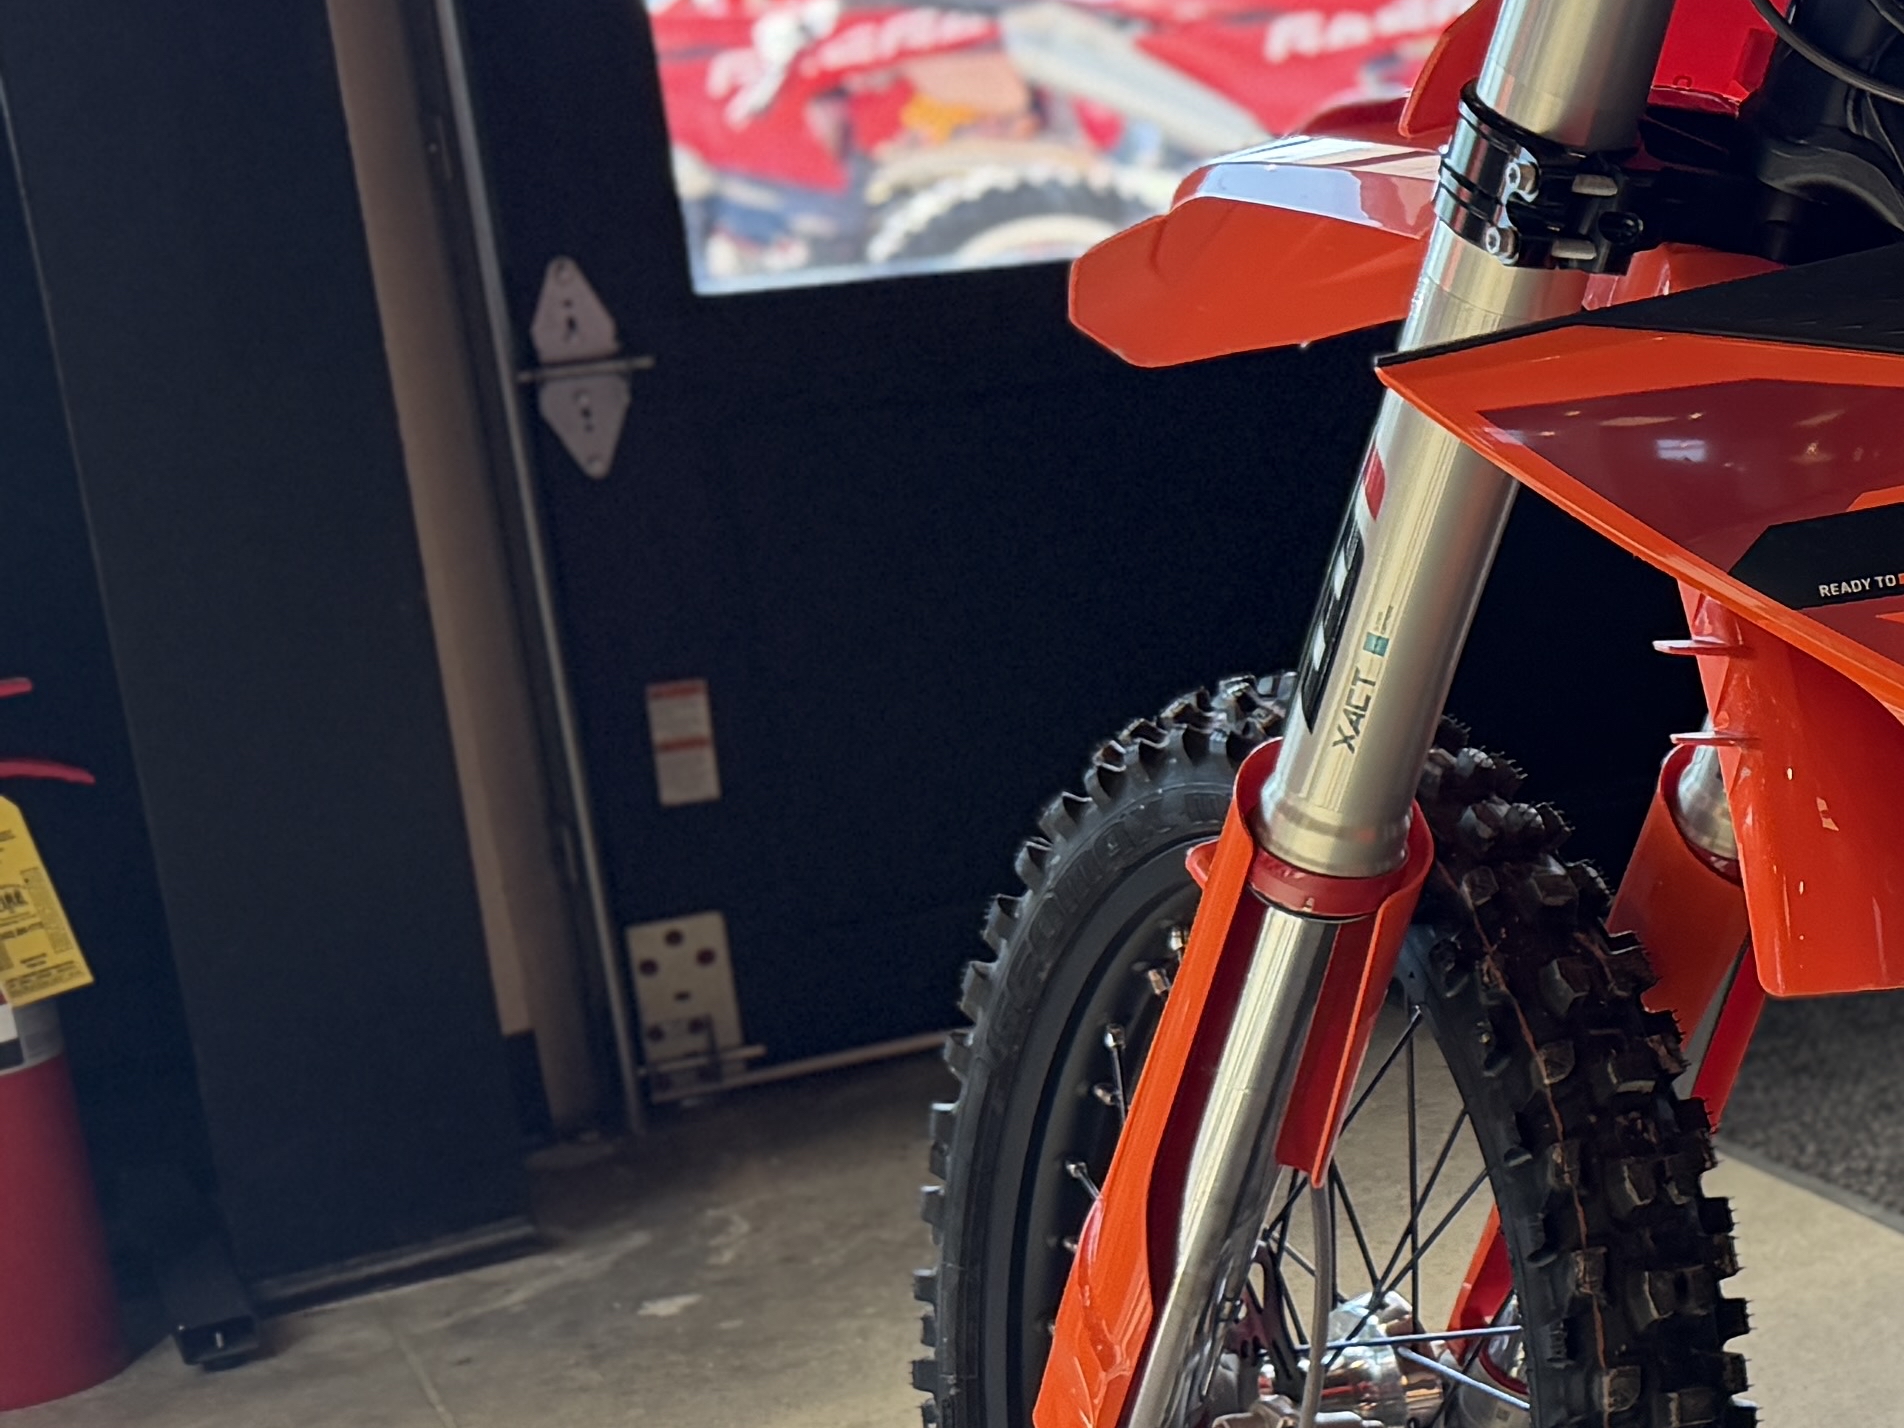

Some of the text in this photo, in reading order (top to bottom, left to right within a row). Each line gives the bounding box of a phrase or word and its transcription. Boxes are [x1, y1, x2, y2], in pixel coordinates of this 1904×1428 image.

[1818, 577, 1871, 598] READY
[1874, 574, 1897, 589] TO
[1332, 667, 1376, 754] XACT
